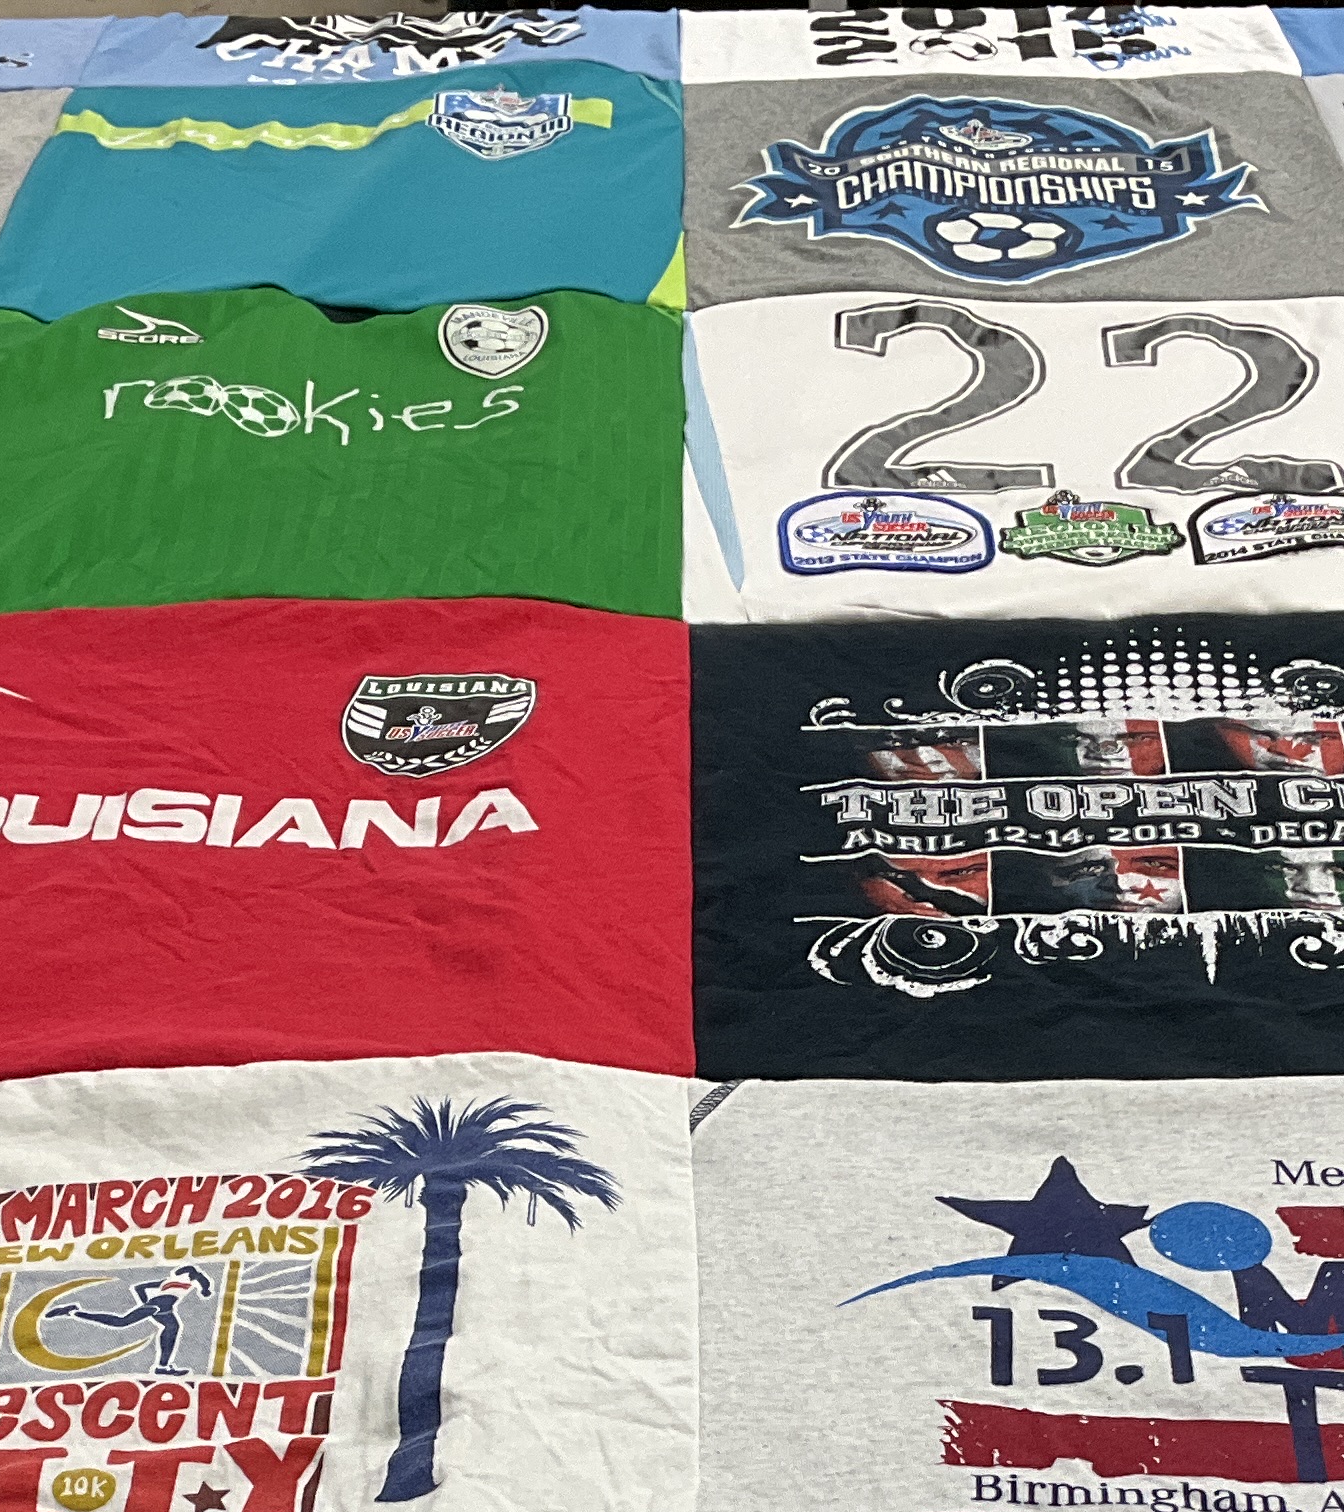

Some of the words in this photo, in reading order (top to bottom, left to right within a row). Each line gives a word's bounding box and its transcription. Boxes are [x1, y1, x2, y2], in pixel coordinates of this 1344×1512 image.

[860, 144, 990, 172] SOUTHERN
[1001, 156, 1125, 173] REGIONAL
[836, 160, 1156, 209] CHAMPIONSHIPS
[895, 553, 982, 564] CHAMPION
[1203, 547, 1248, 563] 2014
[367, 680, 528, 695] LOUISIANA
[823, 786, 1009, 828] THE
[1025, 779, 1257, 822] OPEN
[843, 827, 967, 851] APRIL
[1108, 820, 1203, 842] 2013
[0, 1175, 221, 1239] MARCH
[225, 1174, 377, 1222] 2016
[94, 1225, 321, 1261] ORLEANS
[973, 1305, 1194, 1386] 13.1
